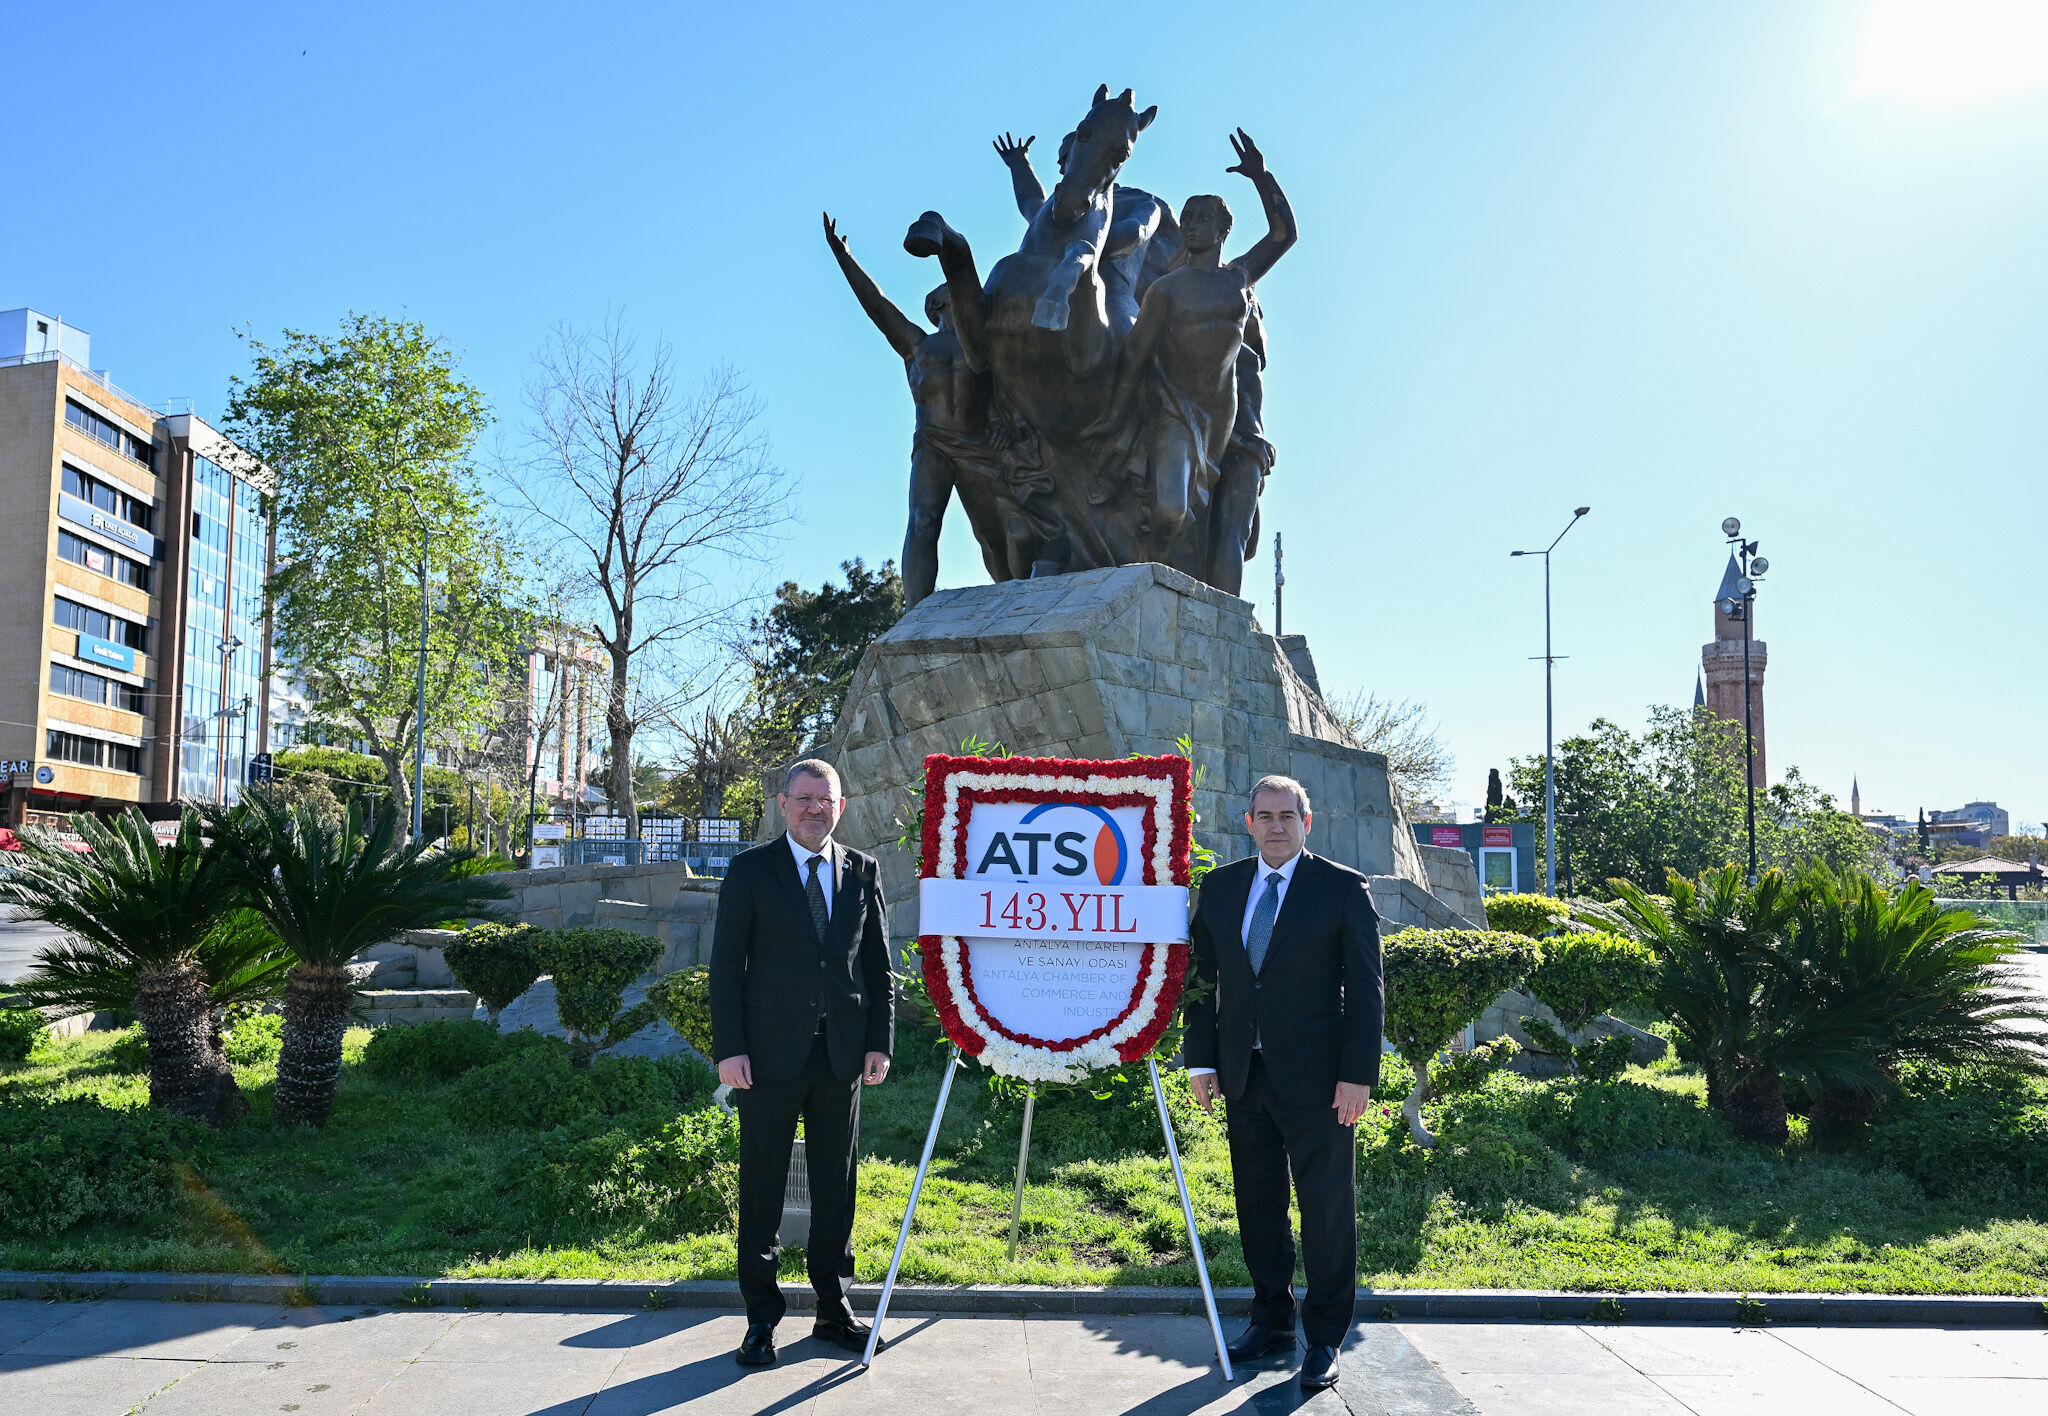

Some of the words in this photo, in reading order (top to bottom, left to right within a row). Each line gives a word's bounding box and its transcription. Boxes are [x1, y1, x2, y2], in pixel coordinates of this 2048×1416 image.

[979, 890, 1137, 933] 143.YIL
[1013, 939, 1069, 951] ANTALYA
[1018, 956, 1035, 967] VE
[1038, 955, 1085, 968] SANAYİ
[1088, 958, 1127, 969] ODASI
[982, 969, 1039, 982] ANTALYA
[1043, 971, 1105, 984] CHAMBER
[1109, 974, 1128, 984] OF
[1022, 987, 1095, 1000] COMMERCE
[1099, 990, 1127, 1002] AND
[1063, 1006, 1120, 1019] INDUSTR
